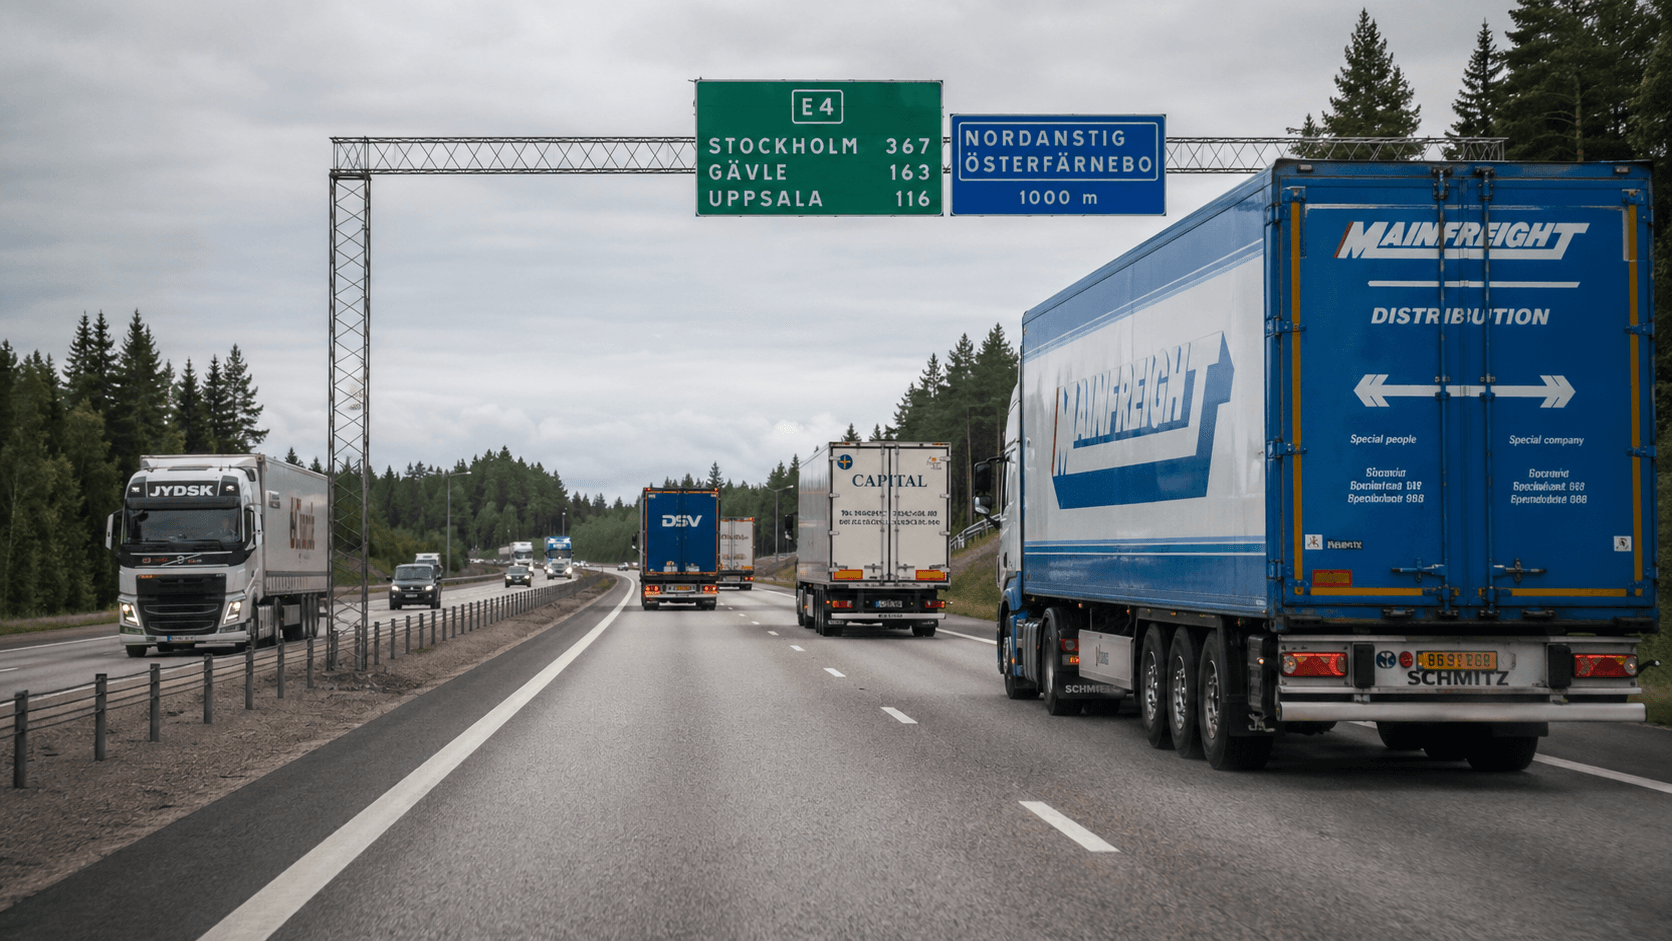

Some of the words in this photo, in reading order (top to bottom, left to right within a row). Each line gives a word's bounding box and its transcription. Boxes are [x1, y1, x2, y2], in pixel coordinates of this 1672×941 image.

[708, 137, 858, 155] STOCKHOLM
[885, 137, 930, 155] 367
[965, 130, 1126, 147] NORDANSTIG
[708, 160, 787, 181] GÄVLE
[889, 163, 930, 181] 163
[965, 152, 1152, 173] ÖSTERFÄRNEBO
[708, 190, 823, 207] UPPSALA
[895, 190, 930, 207] 116
[1019, 190, 1070, 205] 1000
[1082, 193, 1098, 205] m
[1334, 221, 1590, 260] MAINFREIGHT
[1370, 307, 1551, 325] DISTRIBUTION
[1052, 331, 1231, 496] MAINFREIGHT
[1350, 433, 1384, 446] Special
[1385, 434, 1417, 446] people
[1509, 434, 1542, 447] Special
[1543, 437, 1585, 447] company
[851, 473, 928, 488] CAPITAL
[149, 485, 214, 497] JYDSK
[661, 514, 703, 528] DSV
[1407, 670, 1509, 686] SCHMITZ
